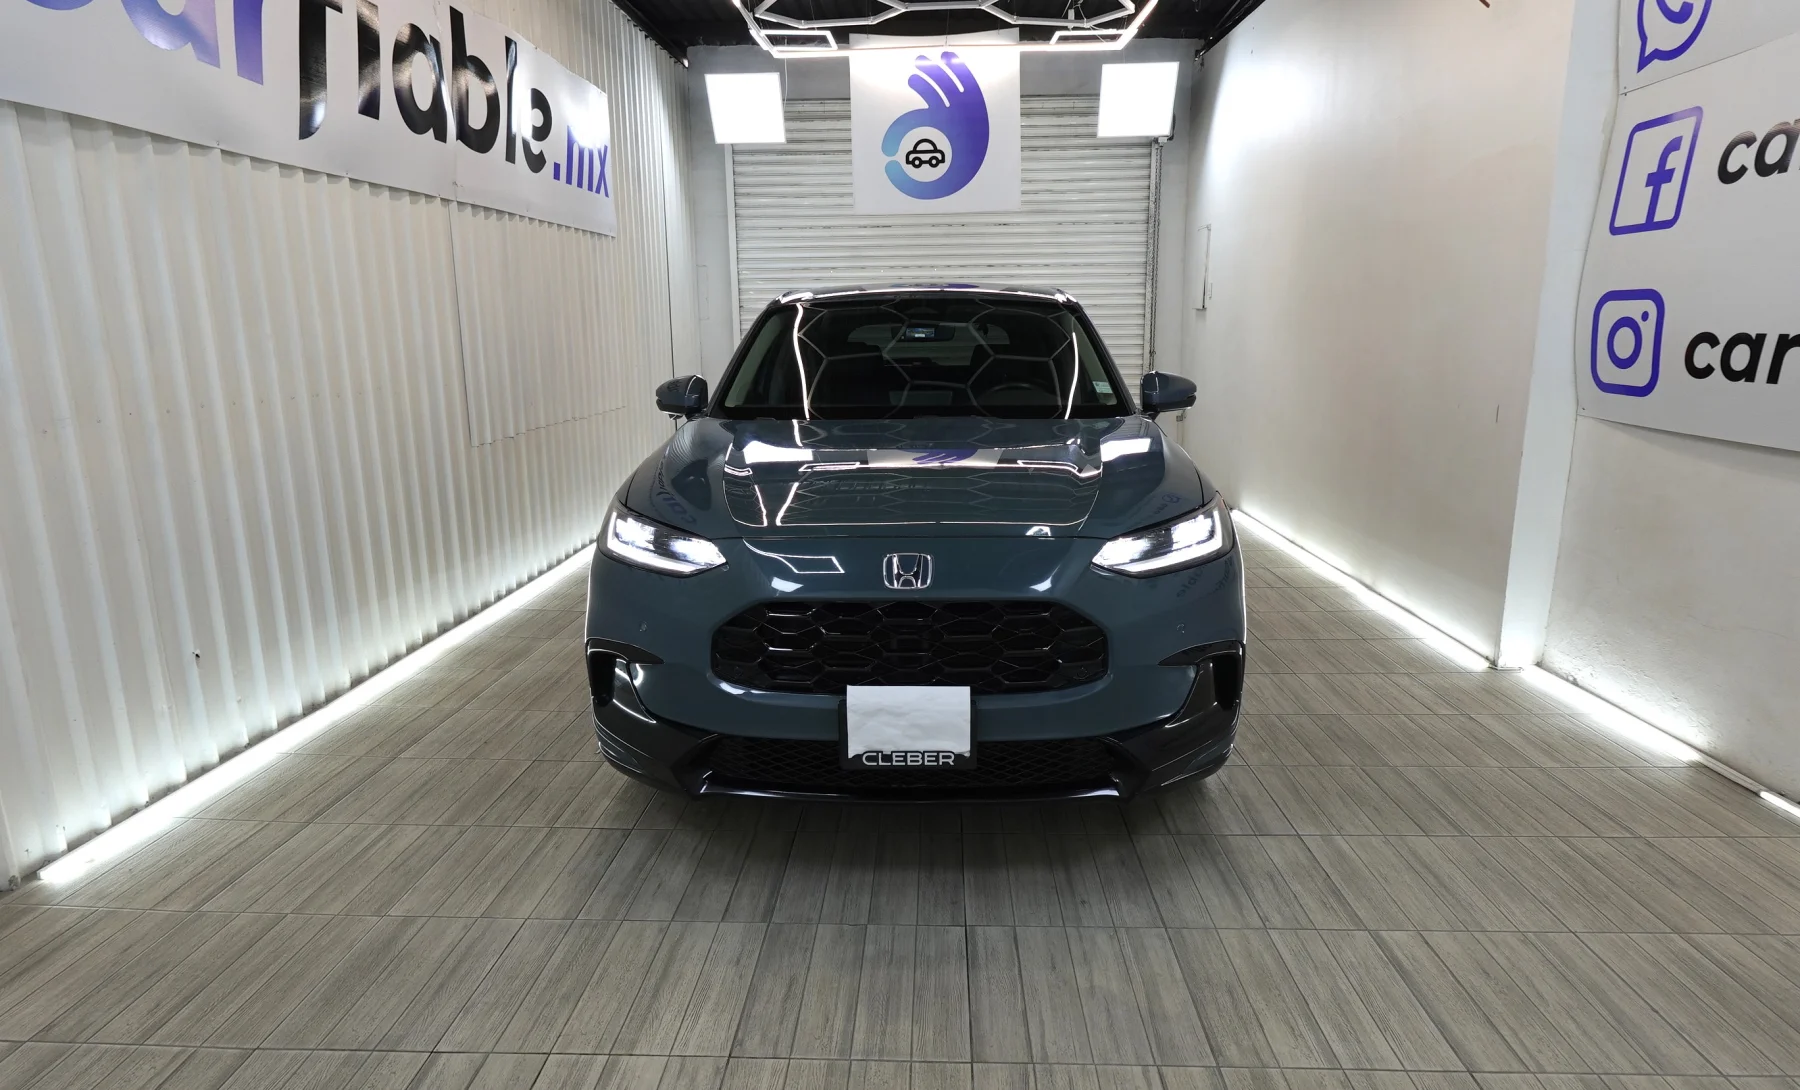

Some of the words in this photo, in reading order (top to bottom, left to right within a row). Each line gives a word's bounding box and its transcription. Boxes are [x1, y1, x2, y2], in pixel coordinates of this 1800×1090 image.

[26, 0, 610, 198] rfiable.mx
[1717, 118, 1800, 185] ca
[1684, 331, 1800, 385] car
[862, 752, 955, 766] CLEBER
